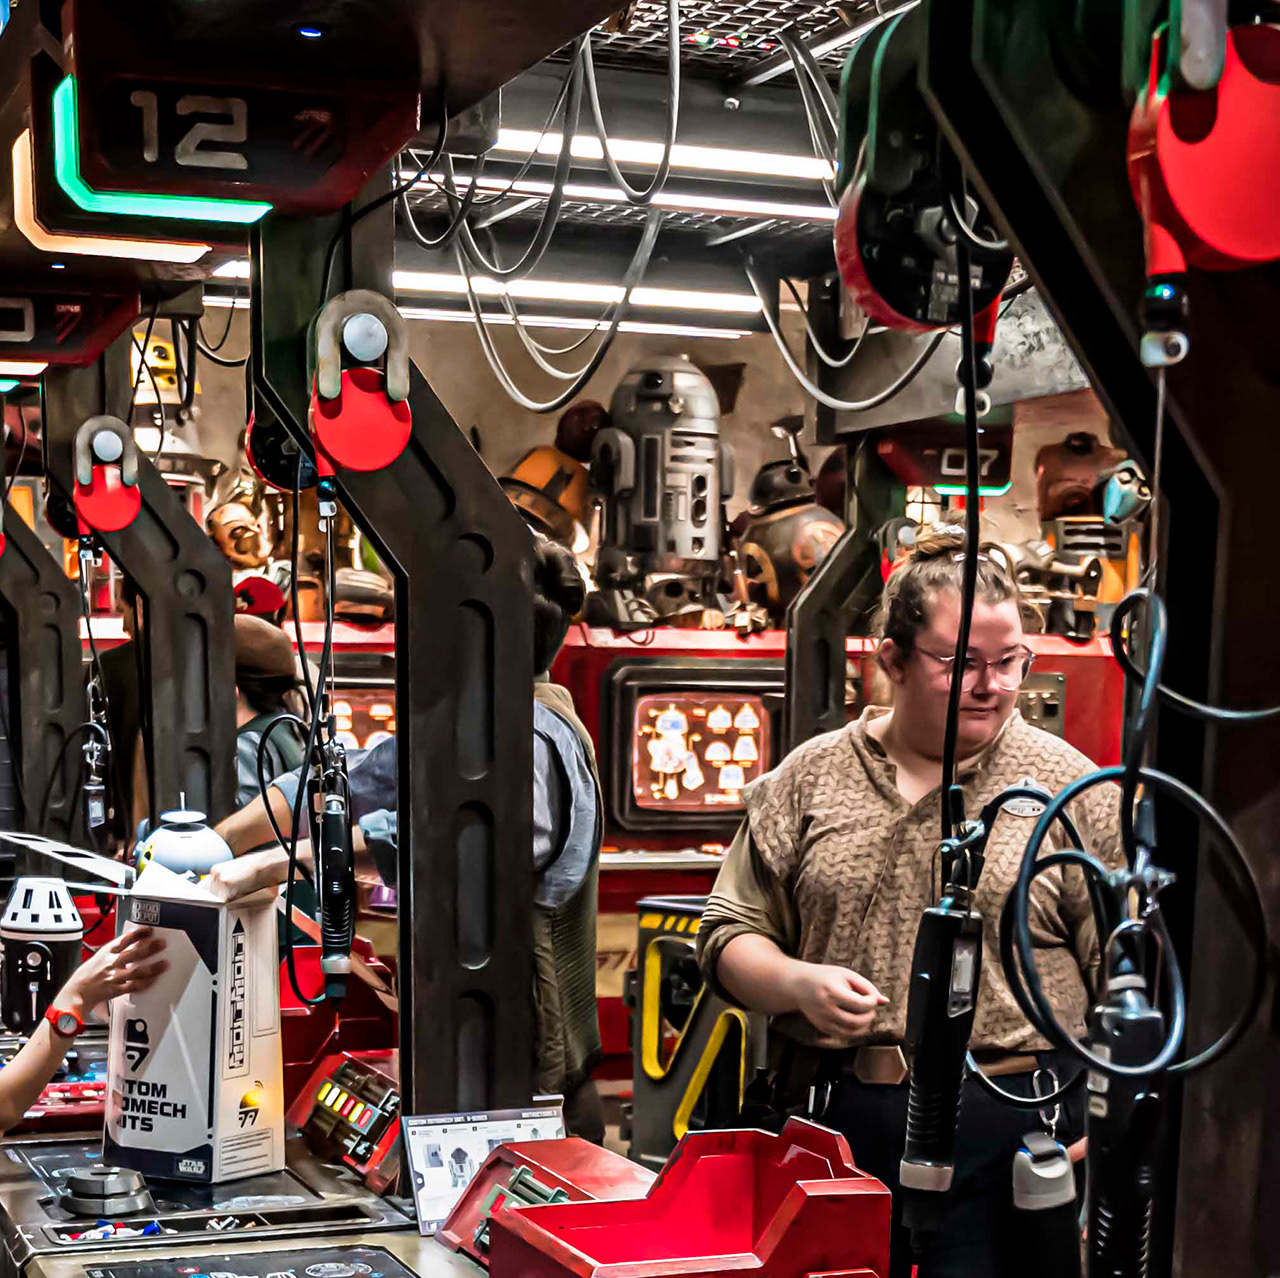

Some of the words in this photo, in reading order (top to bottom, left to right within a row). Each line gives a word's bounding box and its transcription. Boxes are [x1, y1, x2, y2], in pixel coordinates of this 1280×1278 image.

[130, 90, 248, 170] 12
[940, 448, 999, 476] 07
[122, 1080, 167, 1098] TOM
[122, 1097, 186, 1118] OMECH
[120, 1115, 153, 1132] ITS
